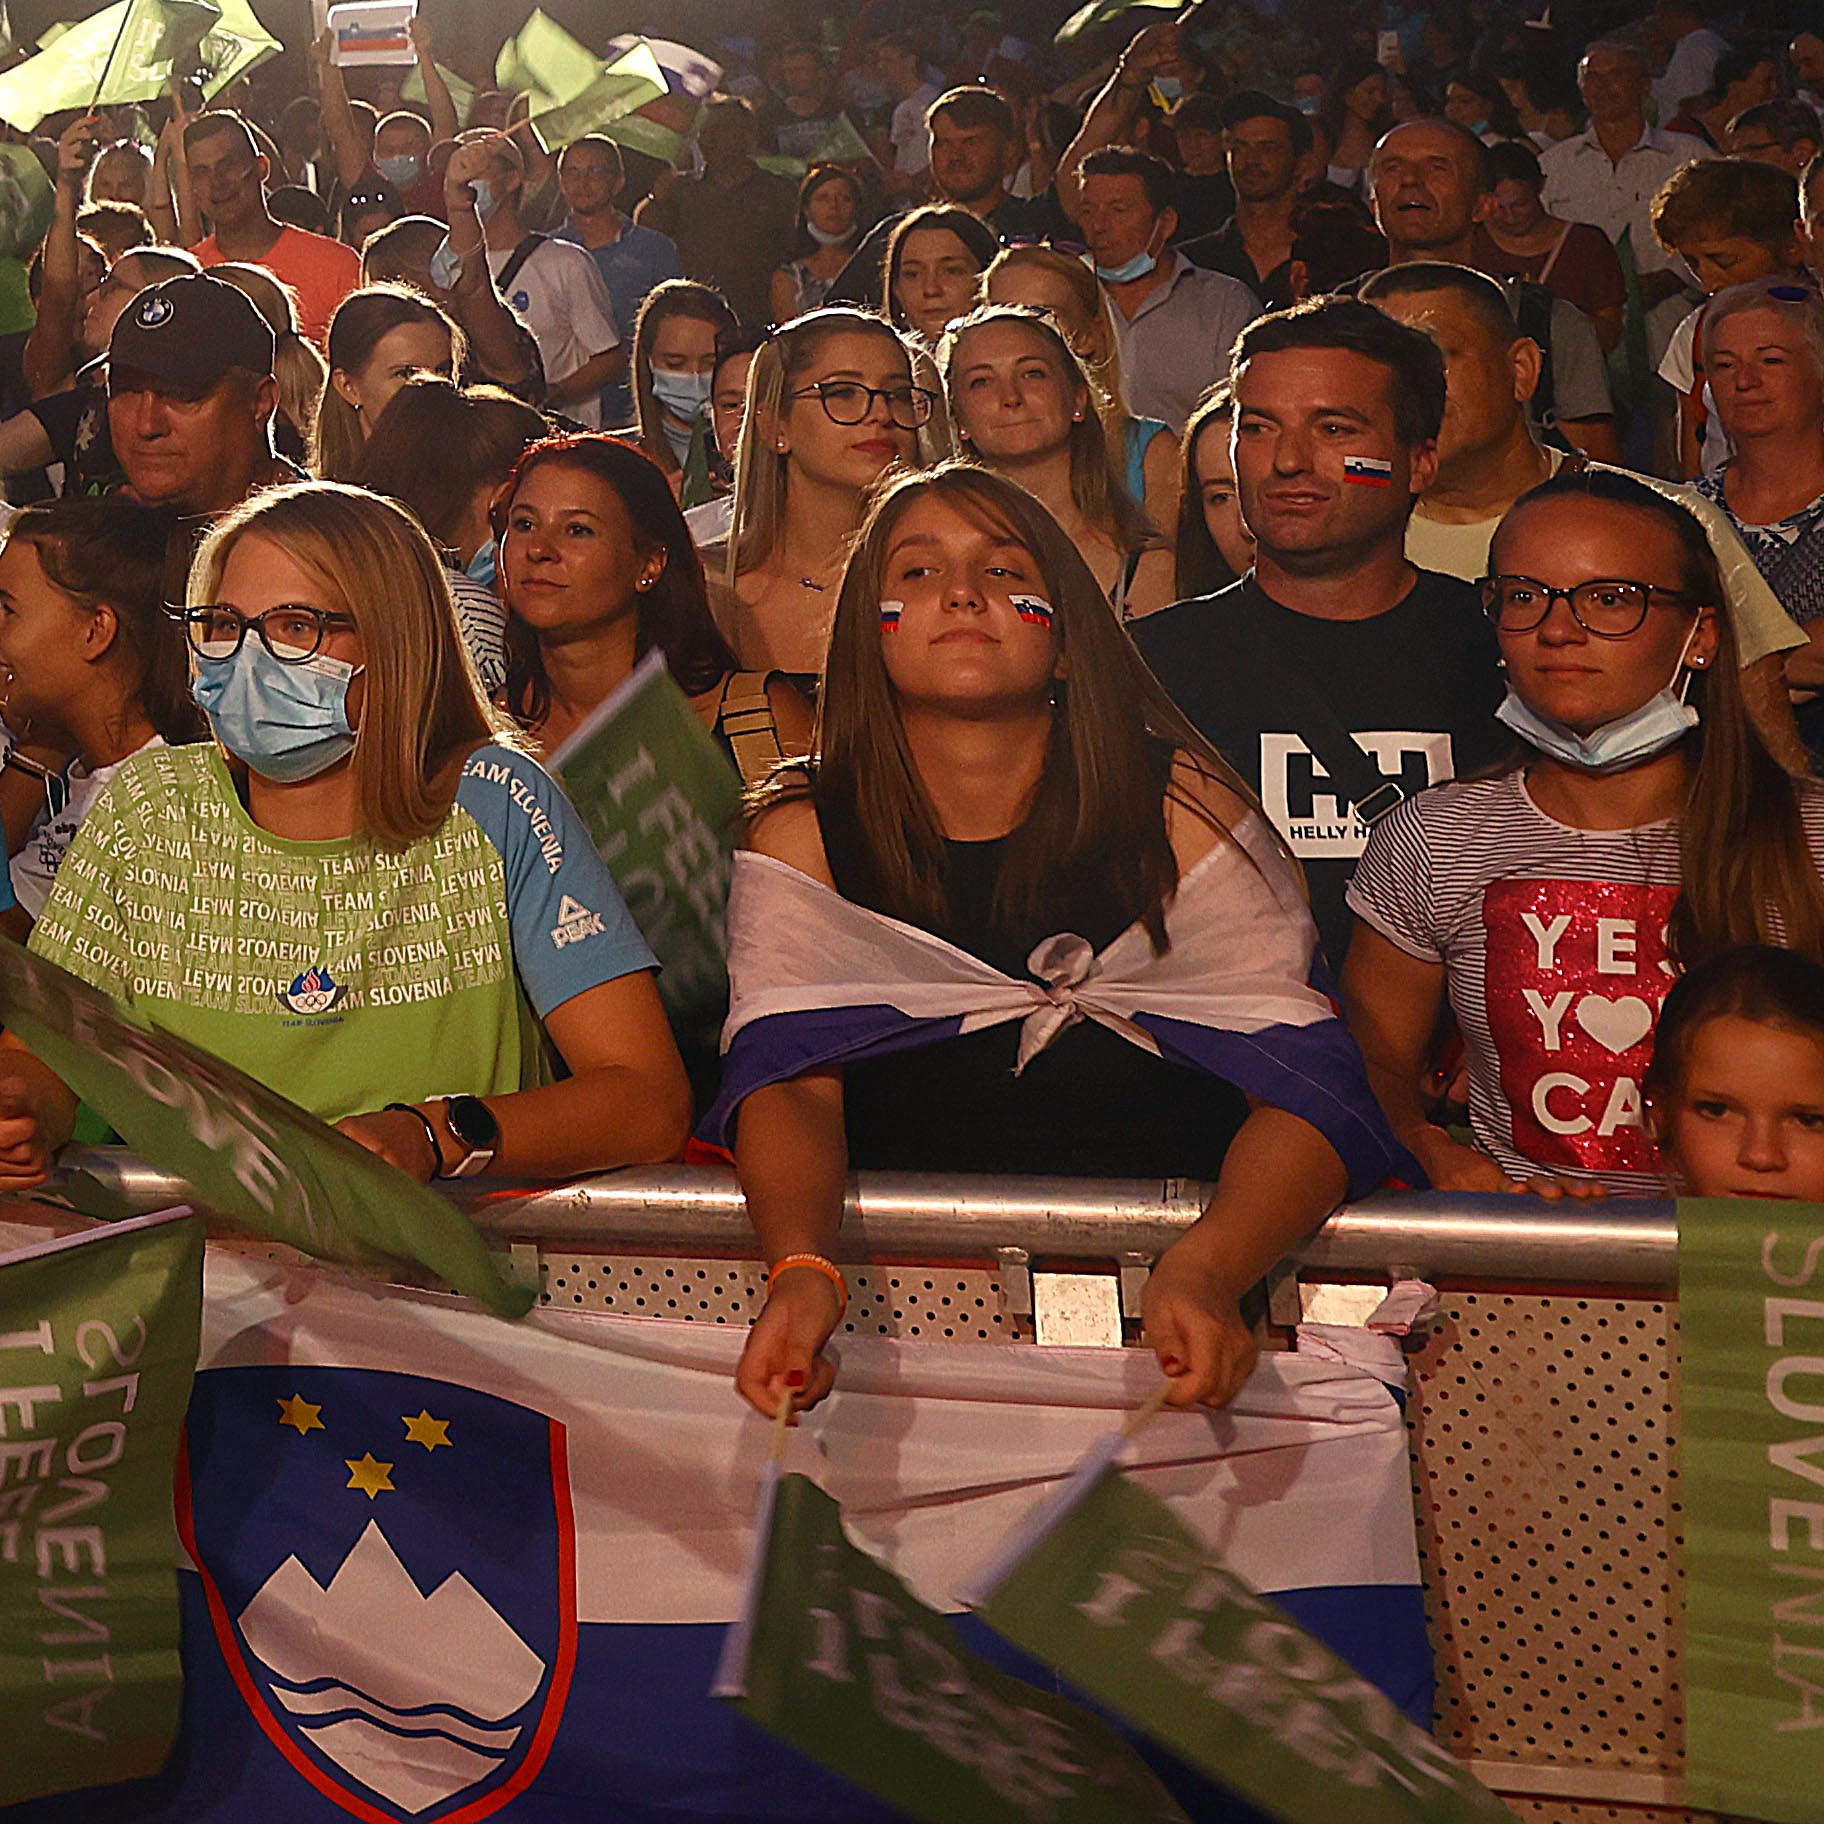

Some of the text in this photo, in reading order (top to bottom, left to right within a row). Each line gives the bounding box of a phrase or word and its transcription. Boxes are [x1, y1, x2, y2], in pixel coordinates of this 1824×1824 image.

[1289, 824, 1349, 840] HELLY
[319, 856, 371, 876] TEAM
[320, 891, 374, 912] TEAM
[37, 914, 73, 947] TEAM
[550, 913, 609, 950] PEAK
[367, 938, 449, 969] SLOVENIA
[369, 976, 453, 1008] SLOVENIA
